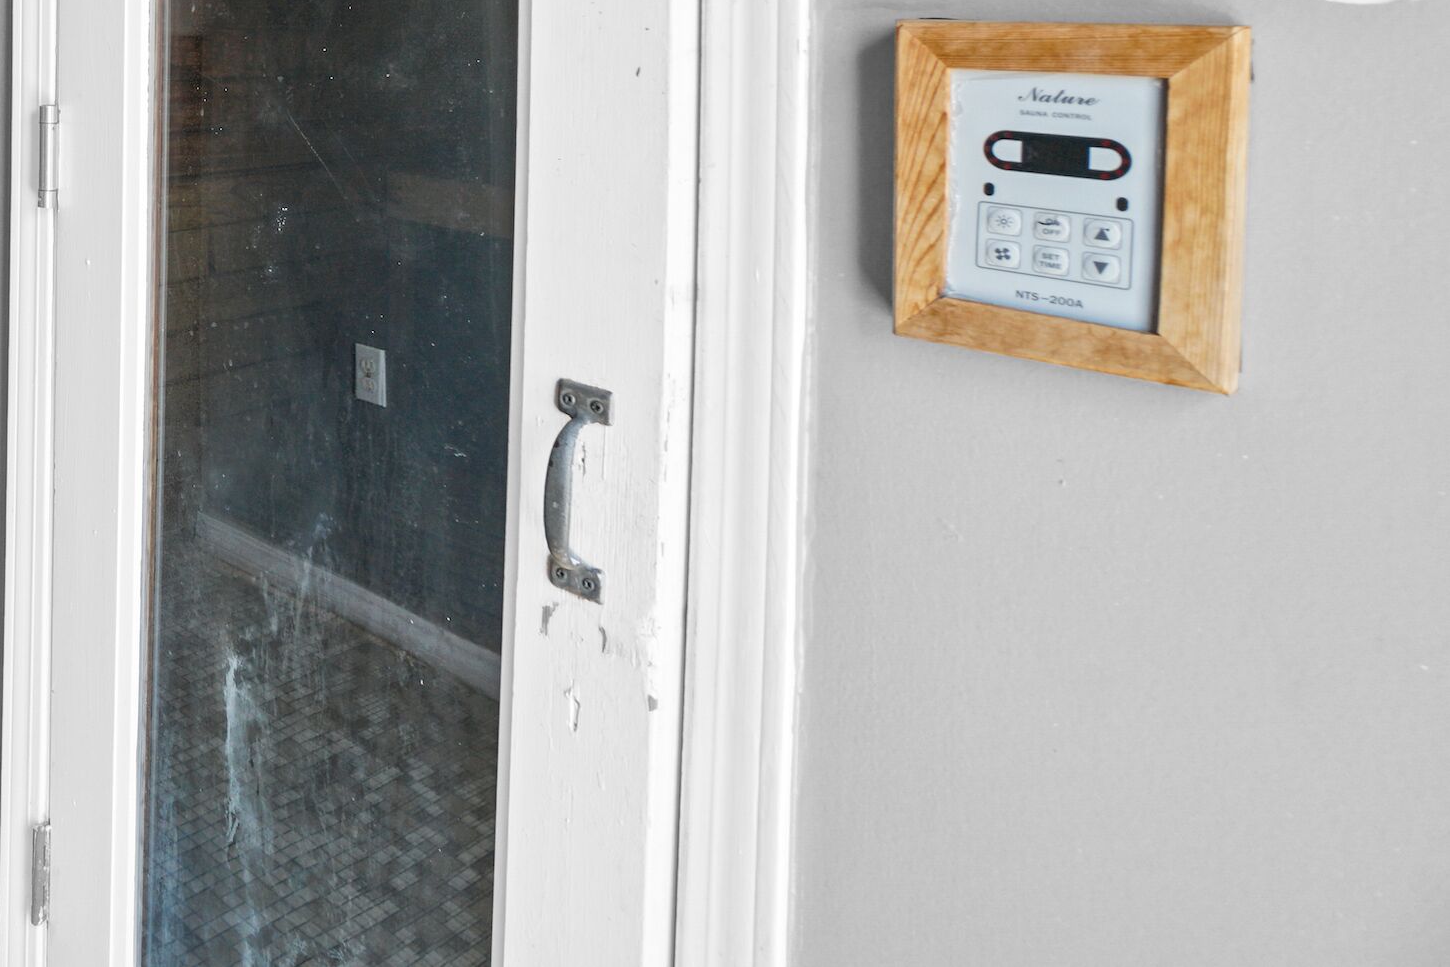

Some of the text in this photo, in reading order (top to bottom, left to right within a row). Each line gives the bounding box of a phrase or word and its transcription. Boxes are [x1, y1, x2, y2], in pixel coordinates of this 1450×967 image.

[1018, 87, 1100, 105] Nature
[1020, 109, 1092, 121] SAUNA CONTROL
[1042, 228, 1061, 236] OFF
[1040, 261, 1062, 270] TIME
